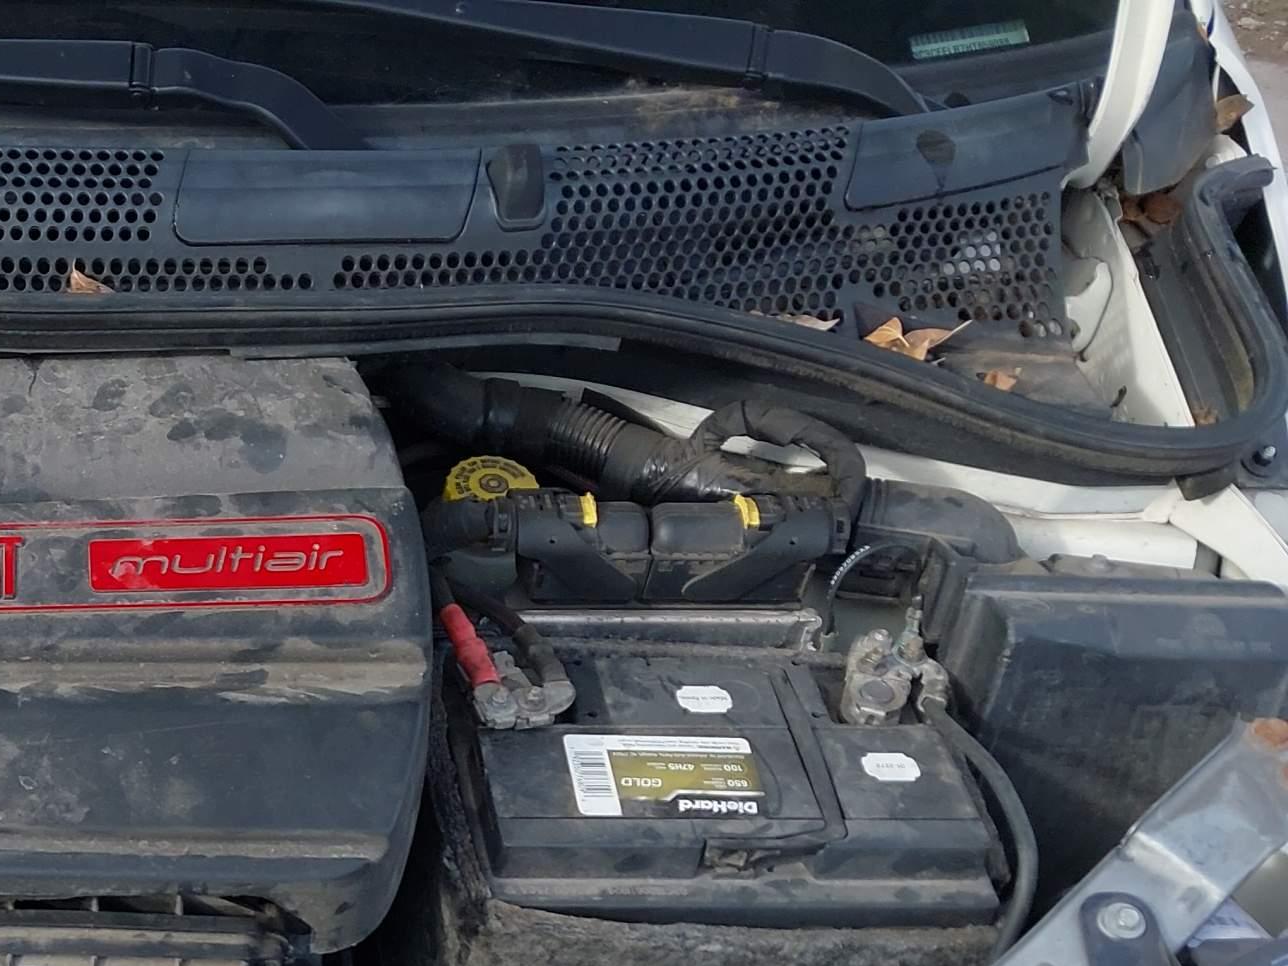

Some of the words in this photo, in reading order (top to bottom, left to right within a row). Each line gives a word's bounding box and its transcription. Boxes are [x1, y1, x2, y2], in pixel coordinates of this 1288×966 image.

[110, 543, 343, 585] multiair
[723, 763, 743, 771] 100
[621, 776, 663, 788] GOLD
[727, 779, 748, 788] 650
[677, 799, 759, 815] DieHard
